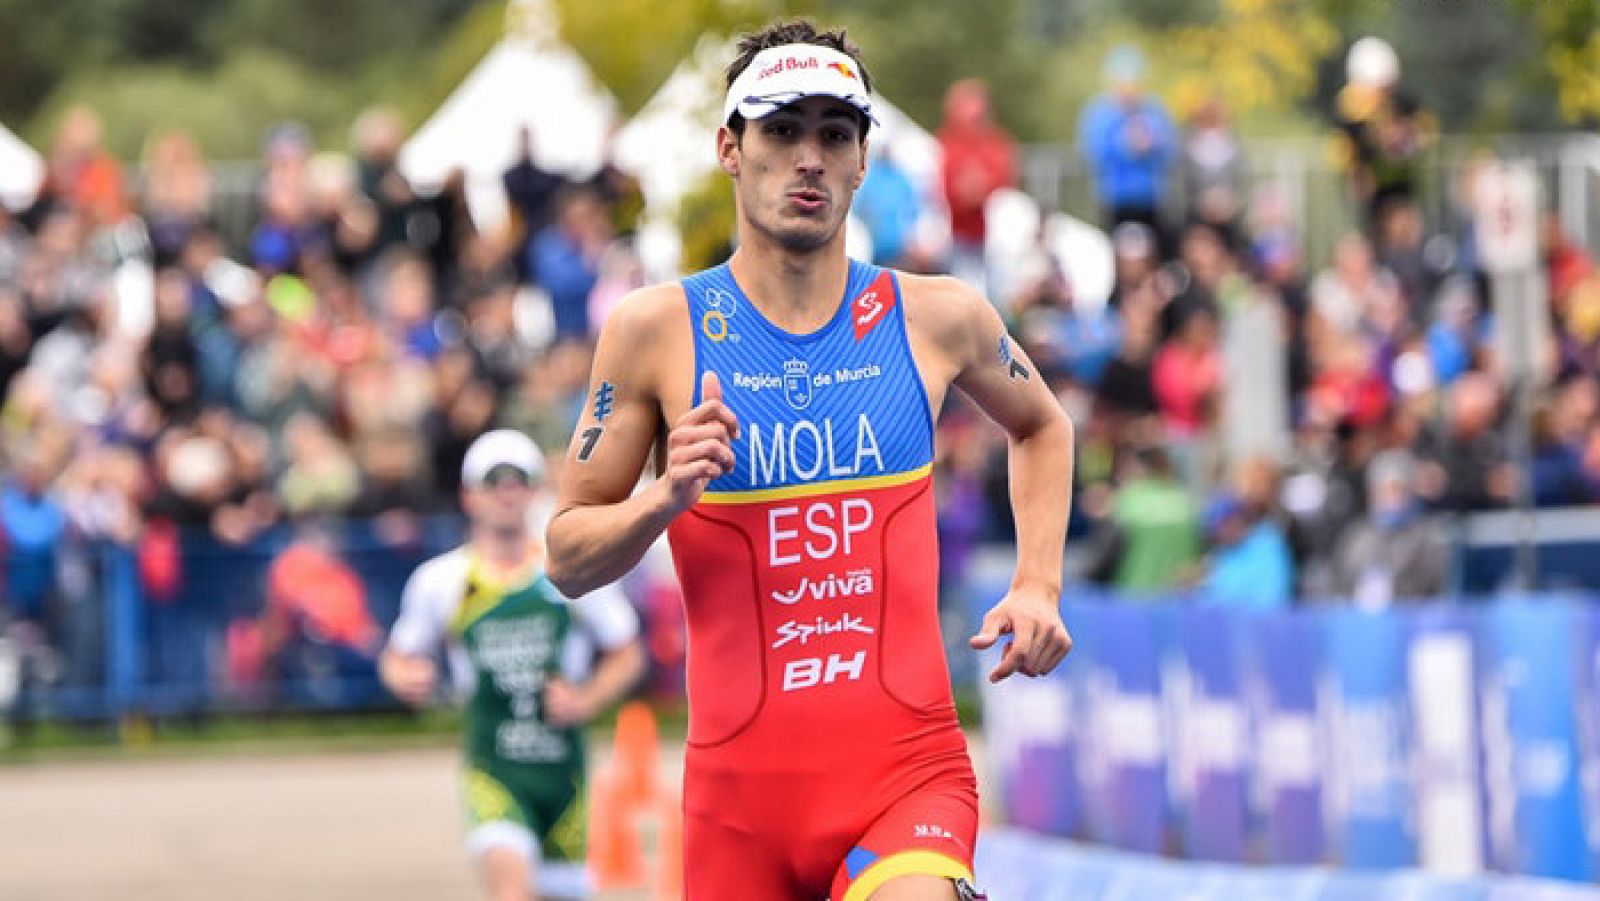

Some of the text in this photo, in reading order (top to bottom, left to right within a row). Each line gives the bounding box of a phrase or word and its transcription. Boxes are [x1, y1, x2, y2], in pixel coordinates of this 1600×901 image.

[786, 57, 819, 70] Bull
[813, 372, 833, 387] de
[836, 363, 881, 383] Murcia
[750, 413, 885, 486] MOLA
[767, 498, 874, 567] ESP
[782, 651, 867, 691] BH
